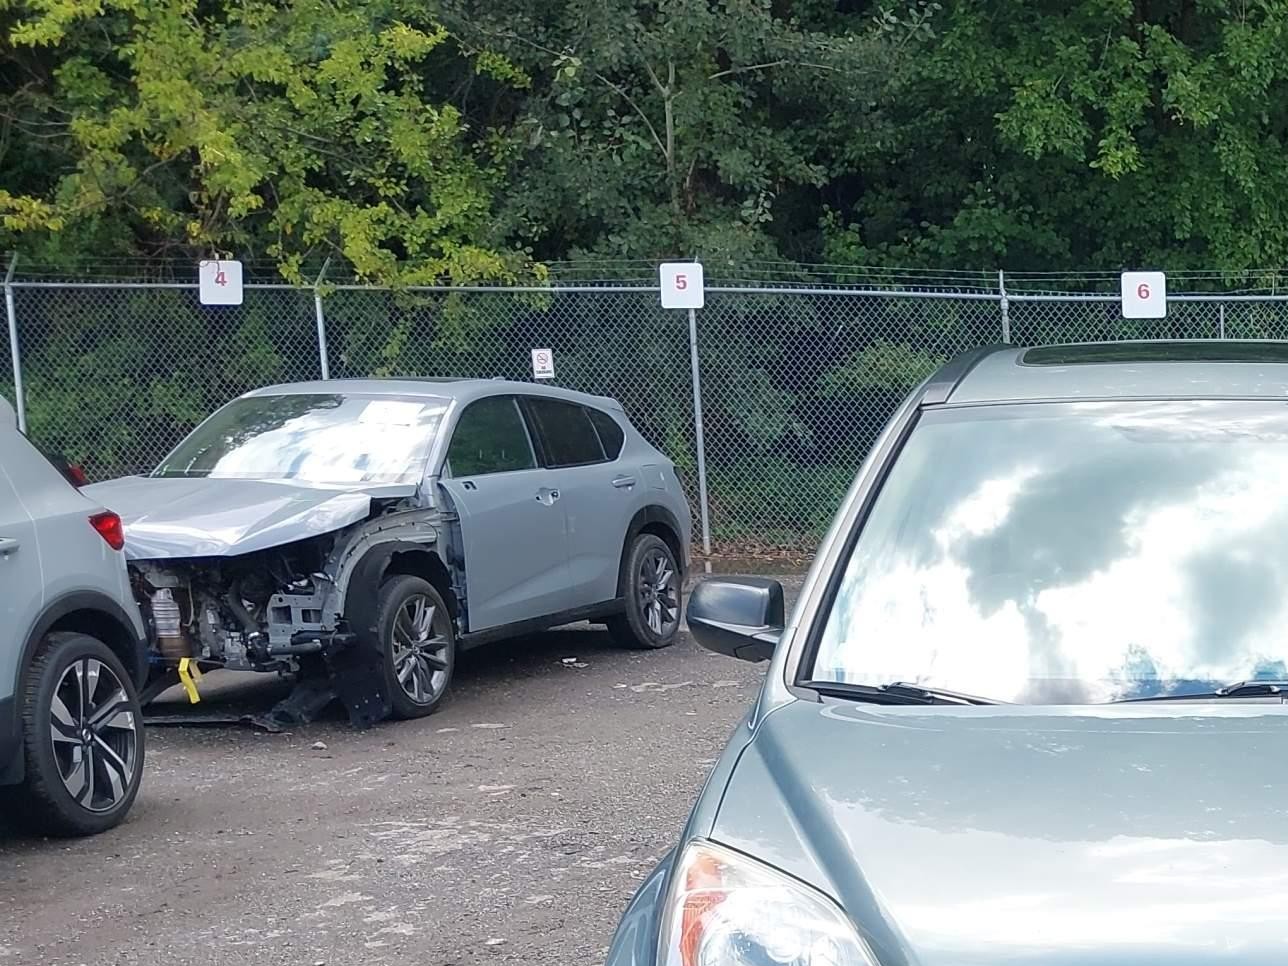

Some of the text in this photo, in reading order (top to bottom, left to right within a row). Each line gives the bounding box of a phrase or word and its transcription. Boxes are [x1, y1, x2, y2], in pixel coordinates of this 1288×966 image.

[214, 271, 227, 287] 4
[676, 274, 687, 290] 5
[1137, 283, 1150, 300] 6
